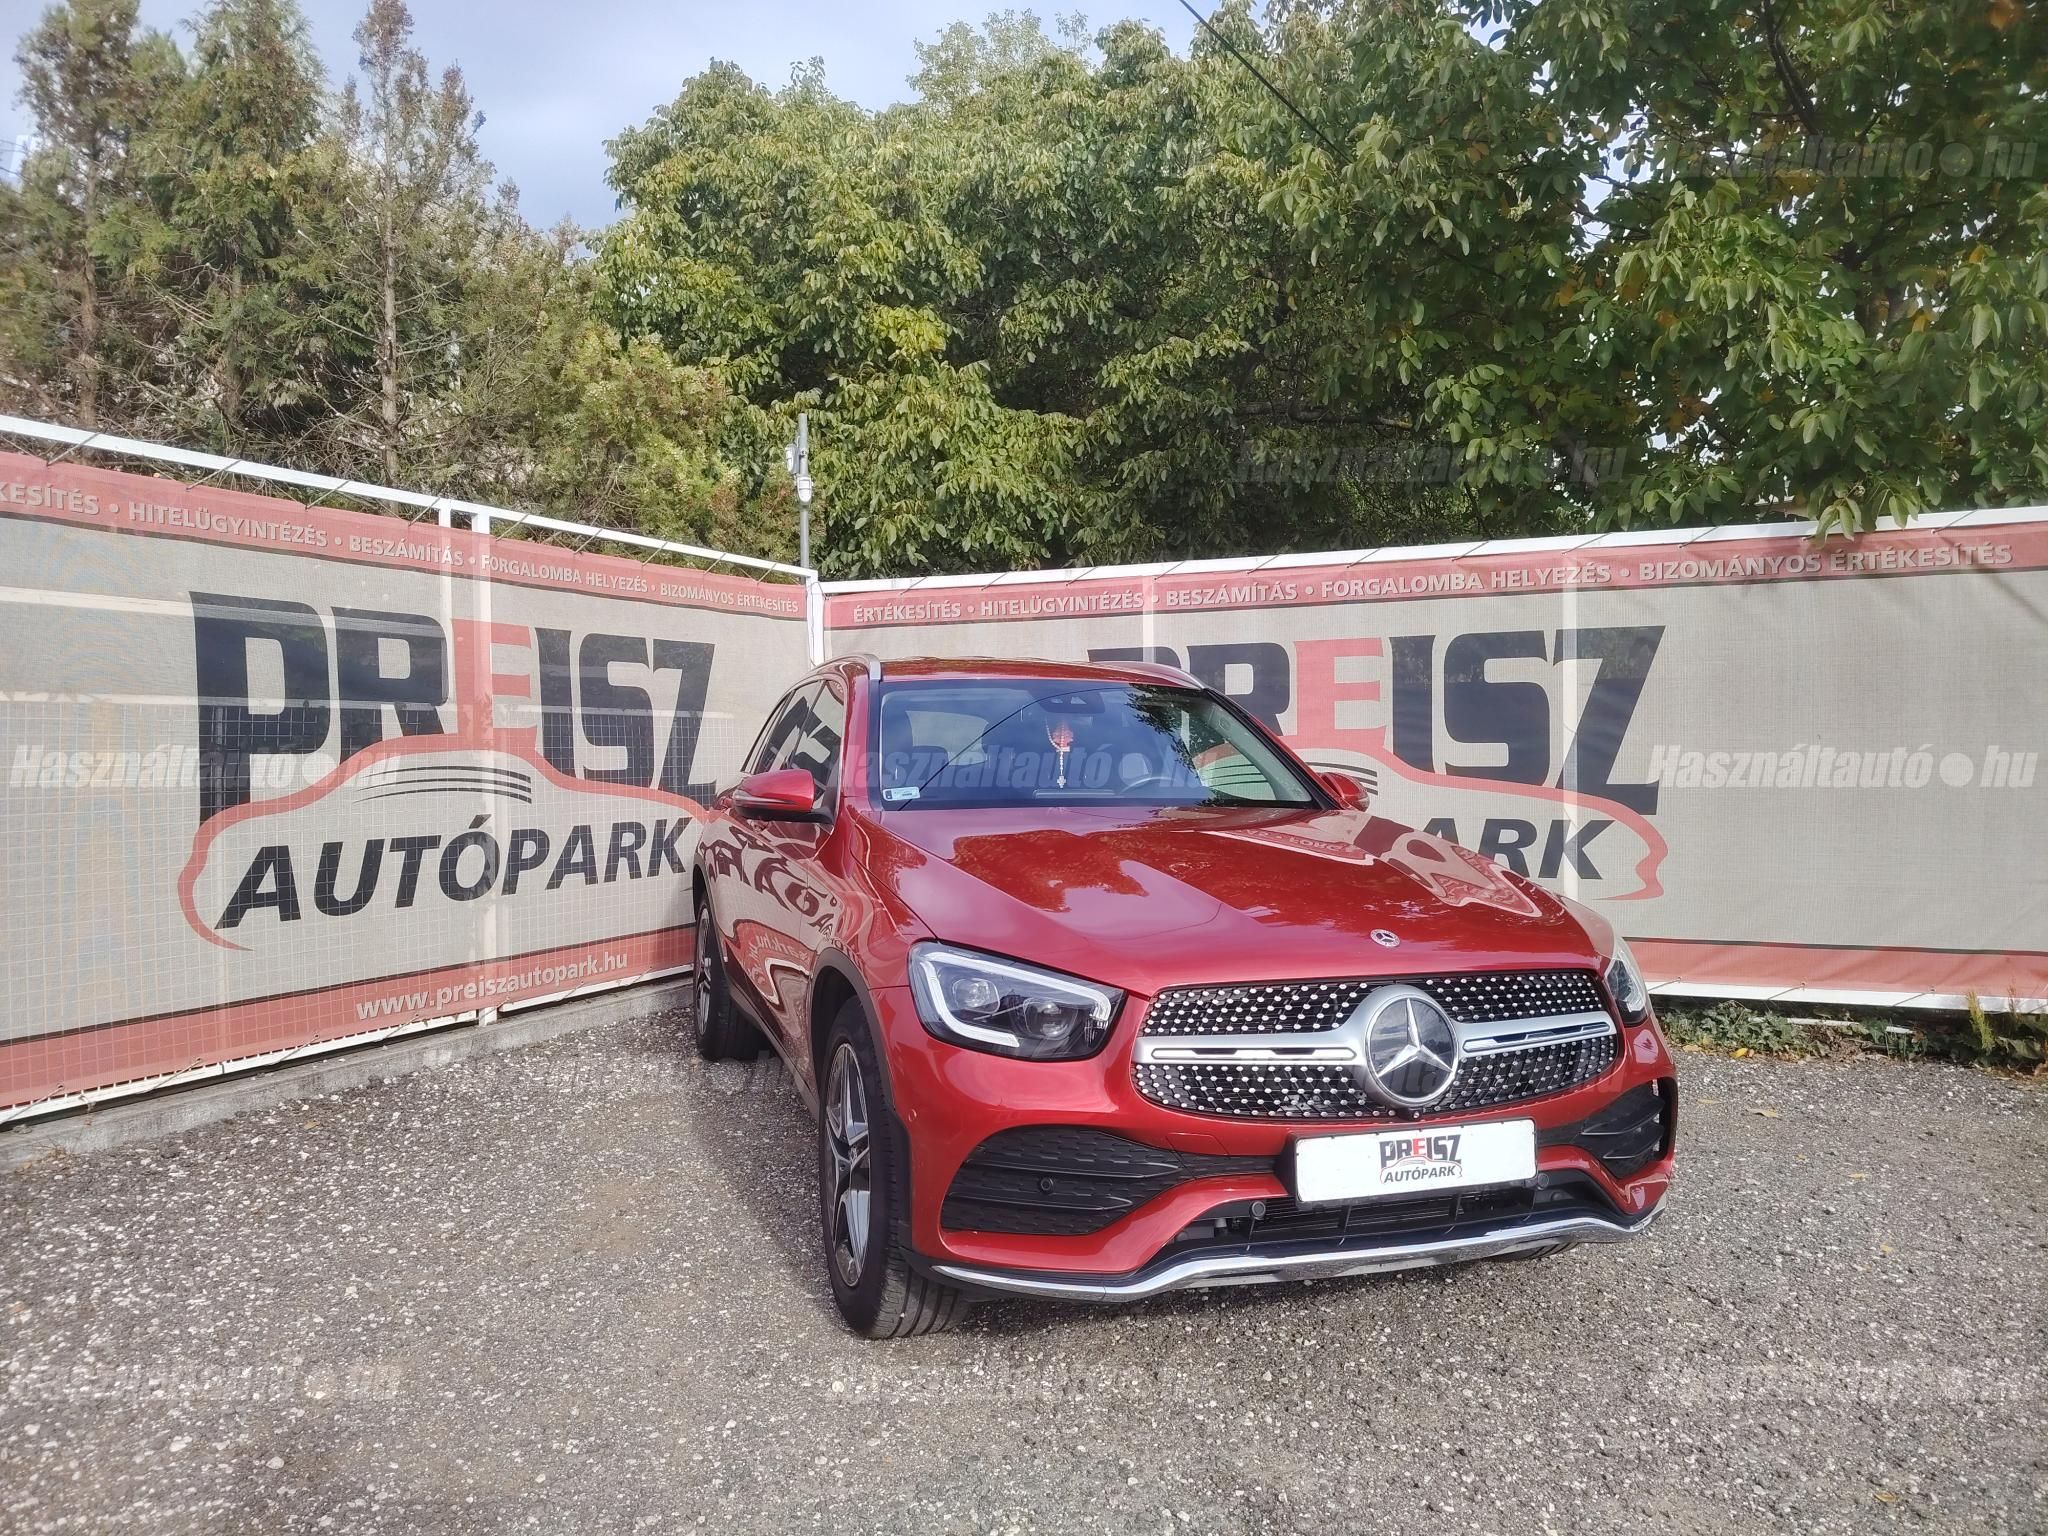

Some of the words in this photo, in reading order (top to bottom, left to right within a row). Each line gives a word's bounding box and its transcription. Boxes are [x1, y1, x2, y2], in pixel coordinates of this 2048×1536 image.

[129, 502, 328, 547] HITELÜGYINTÉZÉS
[350, 535, 464, 567] BESZÁMÍTÁS
[481, 554, 582, 584] FORGALOMBA
[585, 572, 648, 593] HELYEZÉS
[659, 582, 735, 607] BIZOMÁNYOS
[737, 591, 799, 613] ÉRTÉKESÍTÉS
[853, 601, 961, 623] ÉRTÉKESÍTÉS
[981, 590, 1145, 617] HITELÜGYINTÉZÉS
[1166, 583, 1298, 607] BESZÁMÍTÁS
[1321, 572, 1484, 599] FORGALOMBA
[1491, 561, 1611, 589] HELYEZÉS
[1639, 553, 1822, 581] BIZOMÁNYOS
[1830, 542, 2013, 572] ÉRTÉKESÍTÉS
[189, 591, 717, 824] PREISZ
[214, 814, 693, 929] AUTÓPARK
[356, 950, 629, 1020] www.preiszautopark.hu
[1379, 1134, 1462, 1168] PREISZ
[1383, 1166, 1456, 1183] AUTÓPARK
